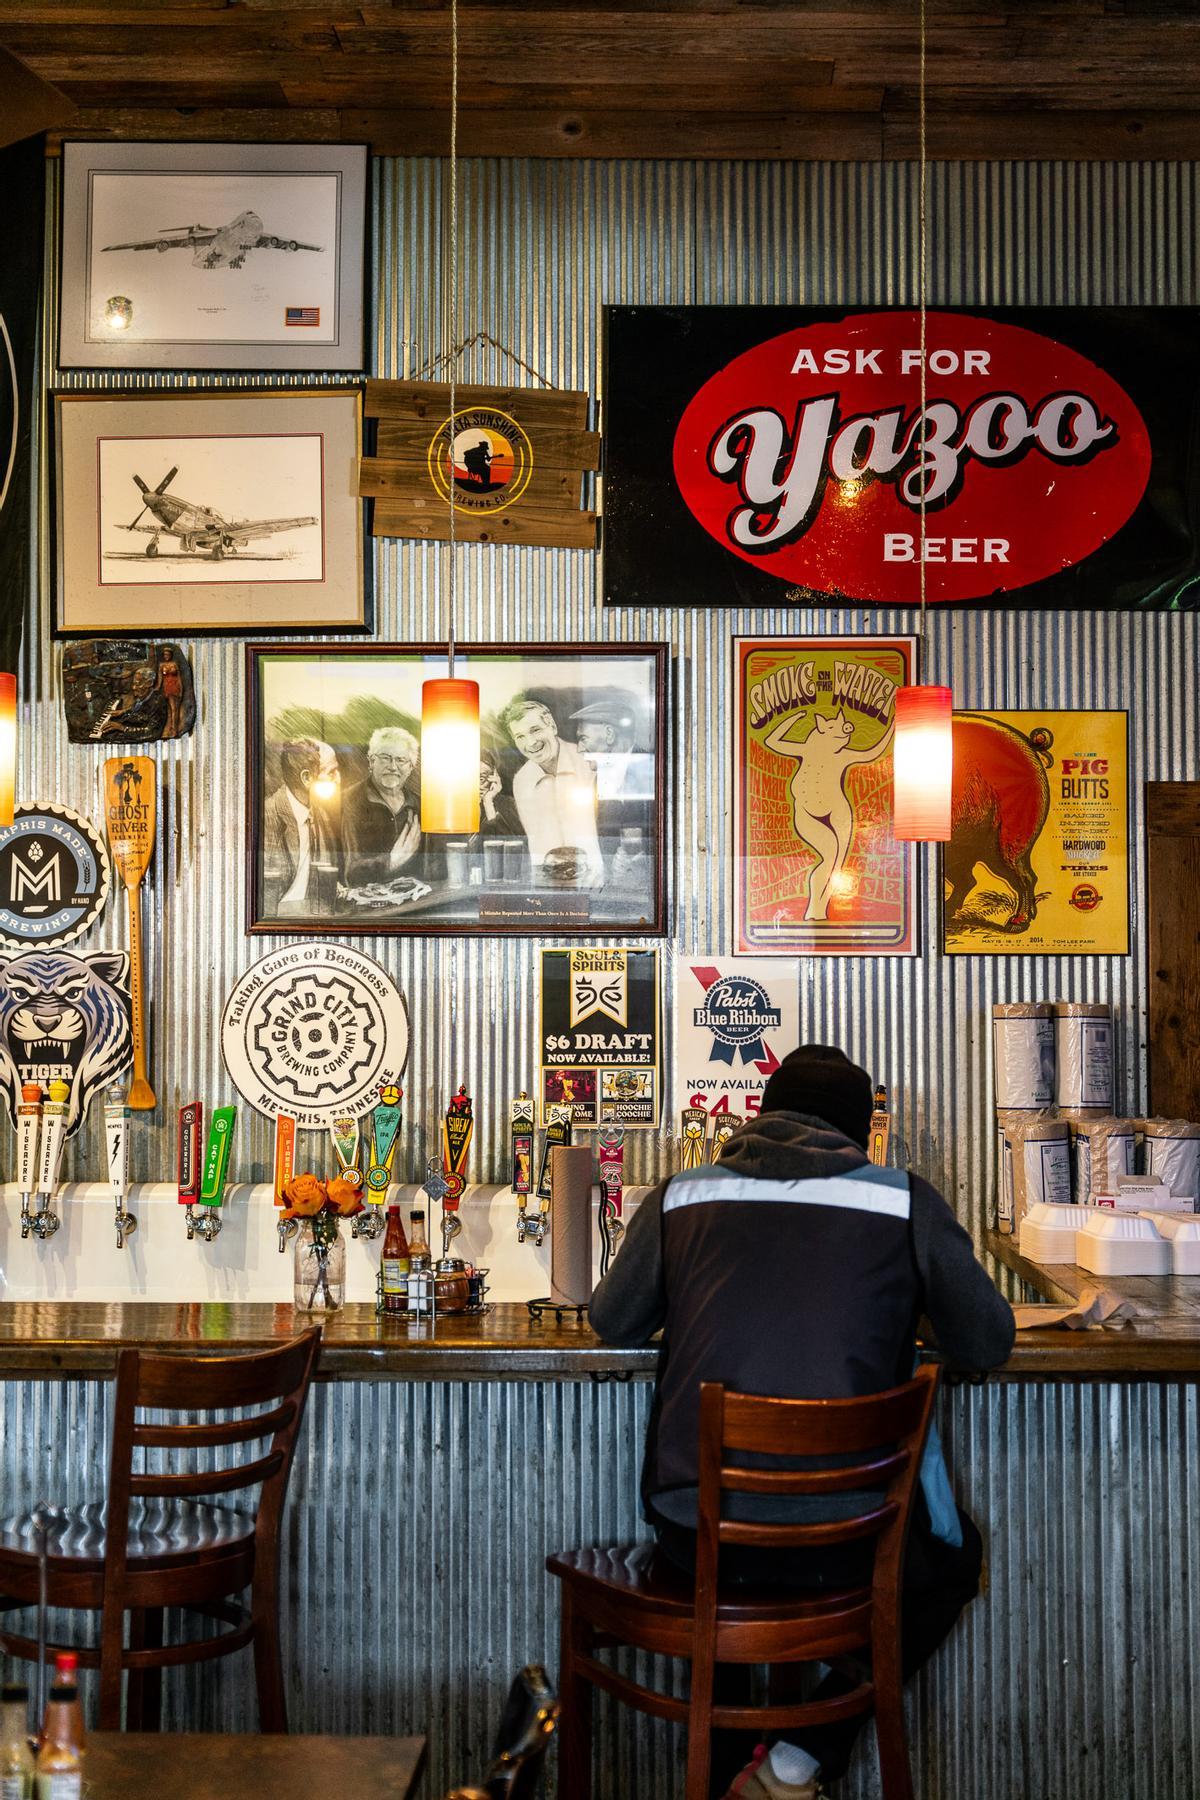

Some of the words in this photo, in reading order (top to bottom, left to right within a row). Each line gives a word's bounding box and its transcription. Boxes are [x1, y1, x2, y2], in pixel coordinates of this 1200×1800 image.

[790, 349, 883, 375] ASK
[901, 349, 991, 376] FOR
[472, 413, 523, 444] SUNSHINE
[710, 393, 1115, 548] Yazoo
[883, 533, 1010, 563] BEER
[818, 670, 831, 680] ON
[750, 661, 816, 728] SMOKE
[816, 681, 833, 692] THE
[1062, 759, 1109, 775] PIG
[1062, 779, 1109, 799] BUTTS
[109, 804, 150, 820] GHOST
[111, 821, 148, 833] RIVER
[0, 820, 46, 842] MPHIS
[51, 823, 87, 858] MADE
[1063, 840, 1106, 851] HARDWOOD
[572, 961, 625, 971] SPIRITS
[229, 974, 264, 1028] Taking
[262, 953, 299, 975] Care
[303, 948, 320, 960] of
[324, 949, 389, 998] Beerness
[715, 985, 758, 1007] Pabst
[271, 992, 317, 1042] GRIND
[323, 994, 358, 1029] CITY
[695, 1009, 727, 1026] Blue
[729, 1008, 779, 1026] Ribbon
[545, 1034, 571, 1051] $6
[574, 1034, 652, 1050] DRAFT
[276, 1045, 320, 1076] BREWING
[323, 1031, 356, 1075] COMPANY
[547, 1054, 576, 1063] NOW
[578, 1053, 651, 1063] AVAILABLE!
[18, 1064, 74, 1080] TIGER
[687, 1079, 717, 1090] NOW
[684, 1110, 706, 1119] MEXICAN
[718, 1117, 741, 1127] SCOTTISH
[448, 1117, 470, 1133] SIREN
[23, 1120, 31, 1183] WISEACRE
[43, 1120, 55, 1183] WISEACRE
[210, 1144, 218, 1161] CAT
[207, 1163, 216, 1179] NAP
